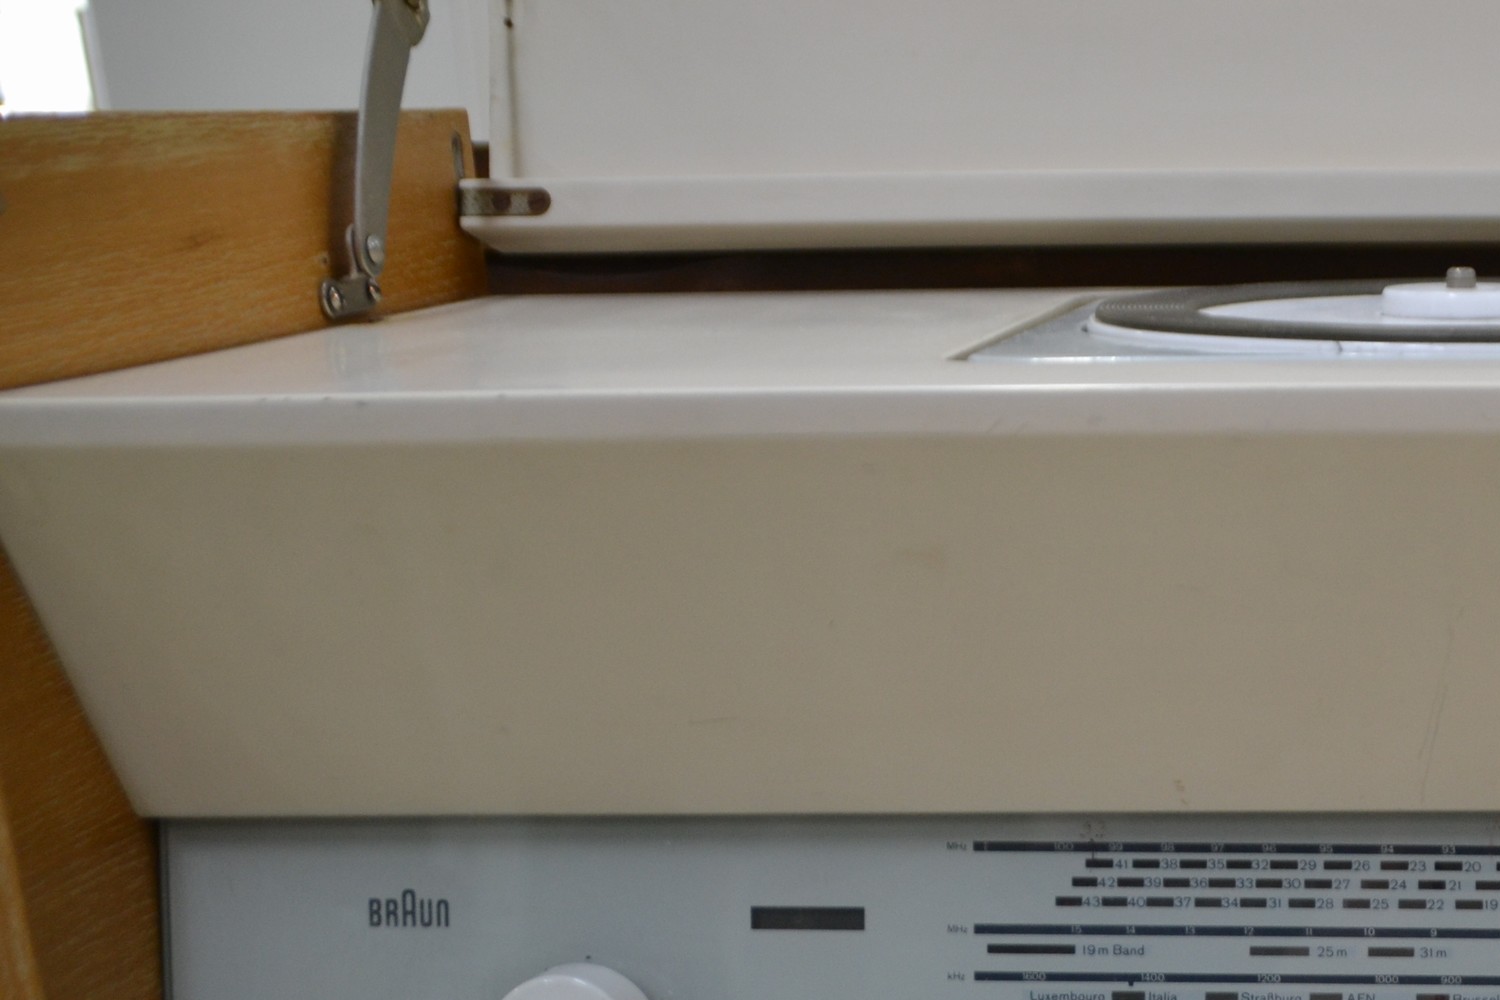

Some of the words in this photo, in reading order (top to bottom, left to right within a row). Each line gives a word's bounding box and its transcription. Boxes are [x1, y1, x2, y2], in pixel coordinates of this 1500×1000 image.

[1114, 859, 1129, 869] 41
[1299, 860, 1317, 871] 29
[1409, 861, 1427, 871] 23
[1098, 878, 1115, 887] 42
[1083, 897, 1100, 907] 43
[368, 888, 449, 927] BRAUN
[1112, 944, 1145, 956] Band
